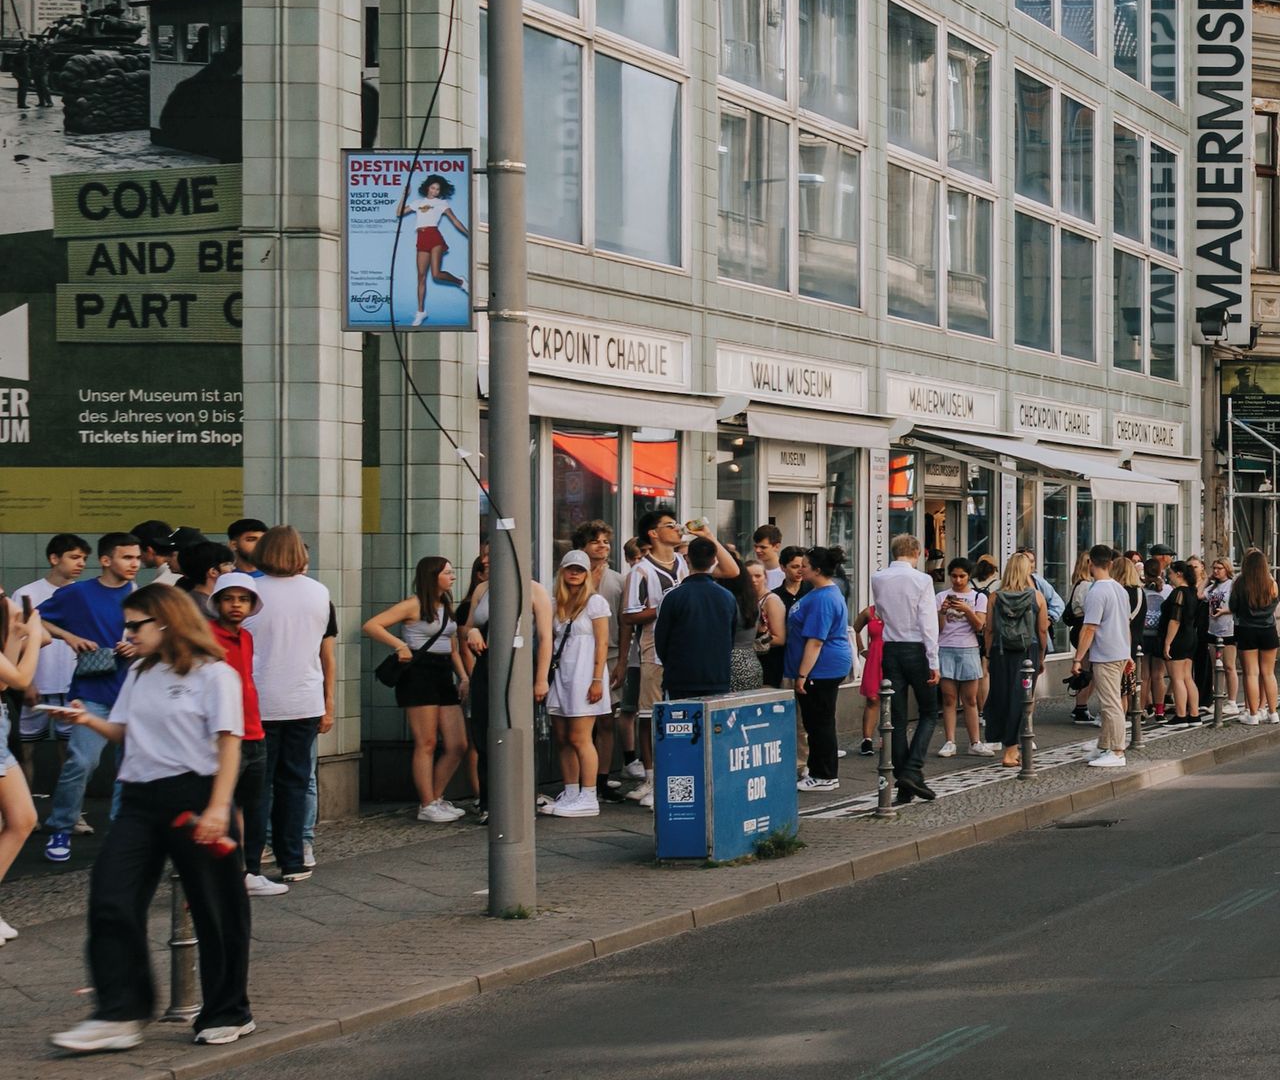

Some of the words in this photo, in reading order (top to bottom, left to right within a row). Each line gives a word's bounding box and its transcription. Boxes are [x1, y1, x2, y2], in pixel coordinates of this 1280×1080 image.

[350, 160, 464, 172] DESTINATION
[350, 174, 402, 186] STYLE
[78, 175, 219, 221] COME
[86, 241, 176, 276] AND
[198, 240, 243, 273] BE
[75, 293, 197, 329] PART
[350, 295, 370, 303] Hard
[528, 323, 600, 367] CKPOINT
[607, 337, 668, 377] CHARLIE
[750, 360, 784, 393] WALL
[786, 367, 833, 399] MUSEUM
[78, 389, 126, 402] Unser
[129, 389, 198, 402] Museum
[201, 389, 221, 402] ist
[909, 386, 975, 419] MAUERMUSEUM
[78, 410, 108, 423] des
[111, 410, 164, 423] Jahres
[167, 413, 194, 423] von
[198, 410, 208, 423] 9
[212, 410, 236, 423] bis
[1019, 404, 1062, 433] CHECKPOINT
[1064, 411, 1091, 436] CHARLIE
[78, 430, 139, 444] Tickets
[142, 430, 175, 444] hier
[177, 430, 198, 444] im
[200, 430, 243, 446] Shop
[1116, 420, 1151, 443] CHECKPOINT
[1153, 425, 1174, 447] CHARLIE
[780, 451, 806, 466] MUSEUM
[668, 724, 691, 733] DDR
[729, 746, 750, 771] LIFE
[752, 743, 762, 767] IN
[764, 740, 782, 765] THE
[747, 775, 767, 801] GDR
